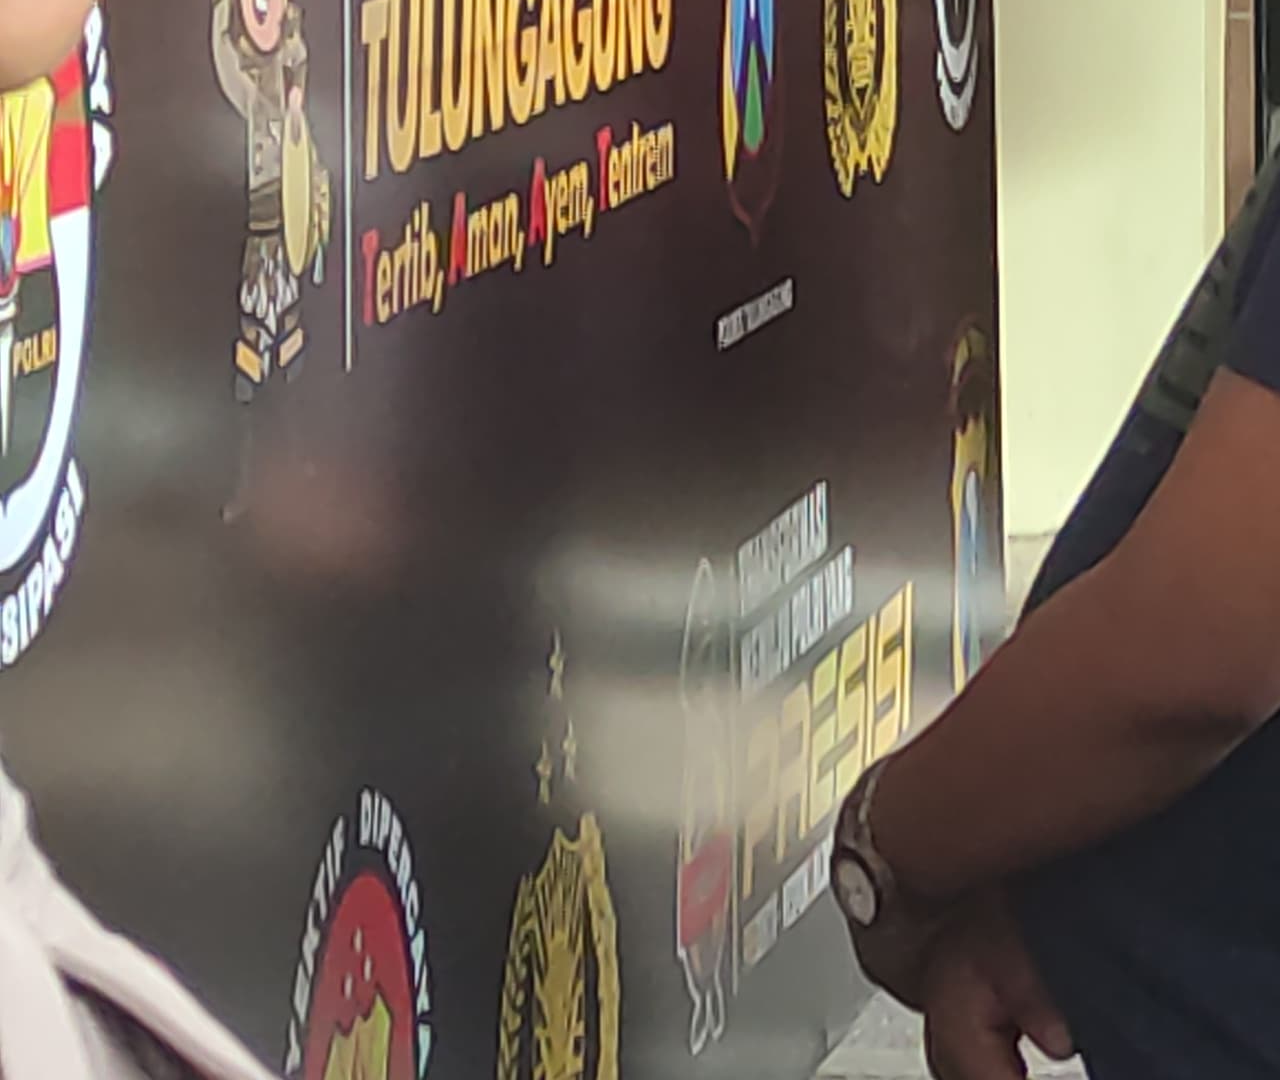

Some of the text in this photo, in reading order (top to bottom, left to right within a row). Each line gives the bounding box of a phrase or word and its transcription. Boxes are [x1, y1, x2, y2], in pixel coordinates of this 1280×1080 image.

[361, 201, 444, 326] Tertib,
[447, 191, 526, 286] Aman,
[527, 157, 594, 266] Ayem,
[0, 456, 85, 668] SIPASI
[742, 580, 915, 900] PRESISI
[286, 815, 345, 1074] YEKTIF
